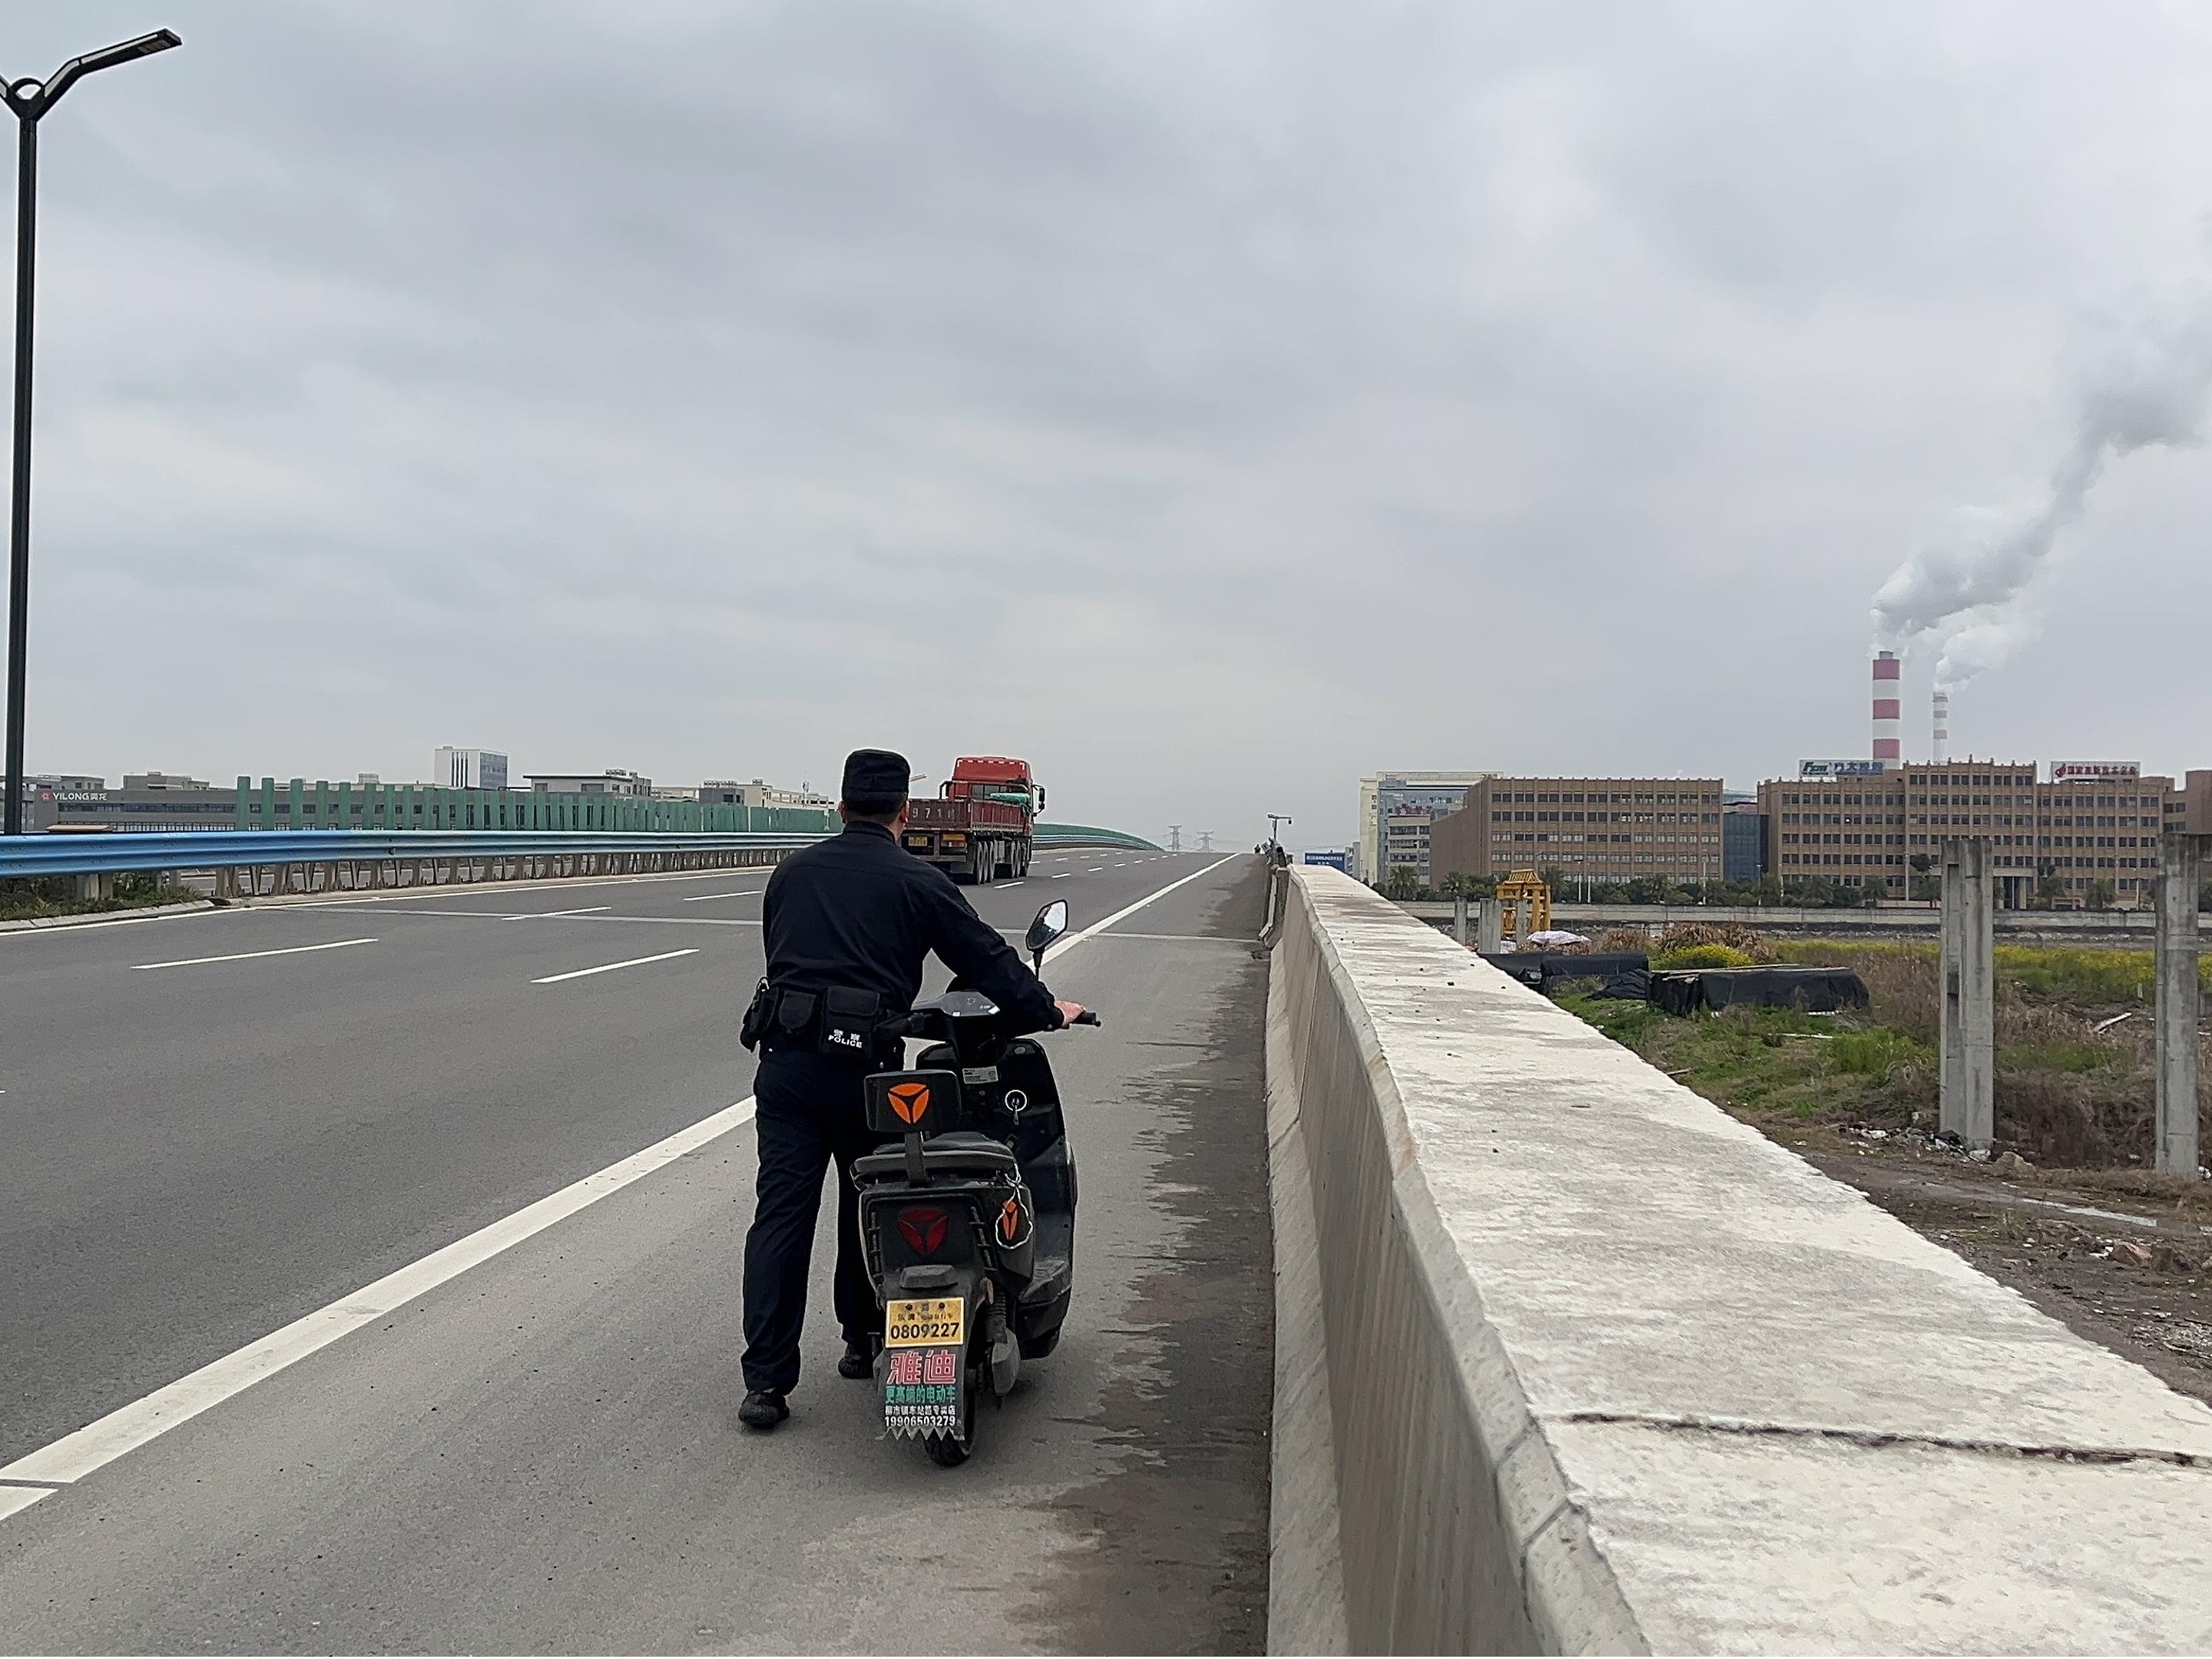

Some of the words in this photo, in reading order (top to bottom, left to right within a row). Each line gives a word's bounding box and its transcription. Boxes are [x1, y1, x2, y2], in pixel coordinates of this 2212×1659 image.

[53, 792, 89, 800] YILONG
[828, 1035, 862, 1048] POLICE
[890, 1322, 959, 1339] 0809227
[887, 1349, 956, 1384] 雅迪
[885, 1416, 955, 1427] 19906503279
